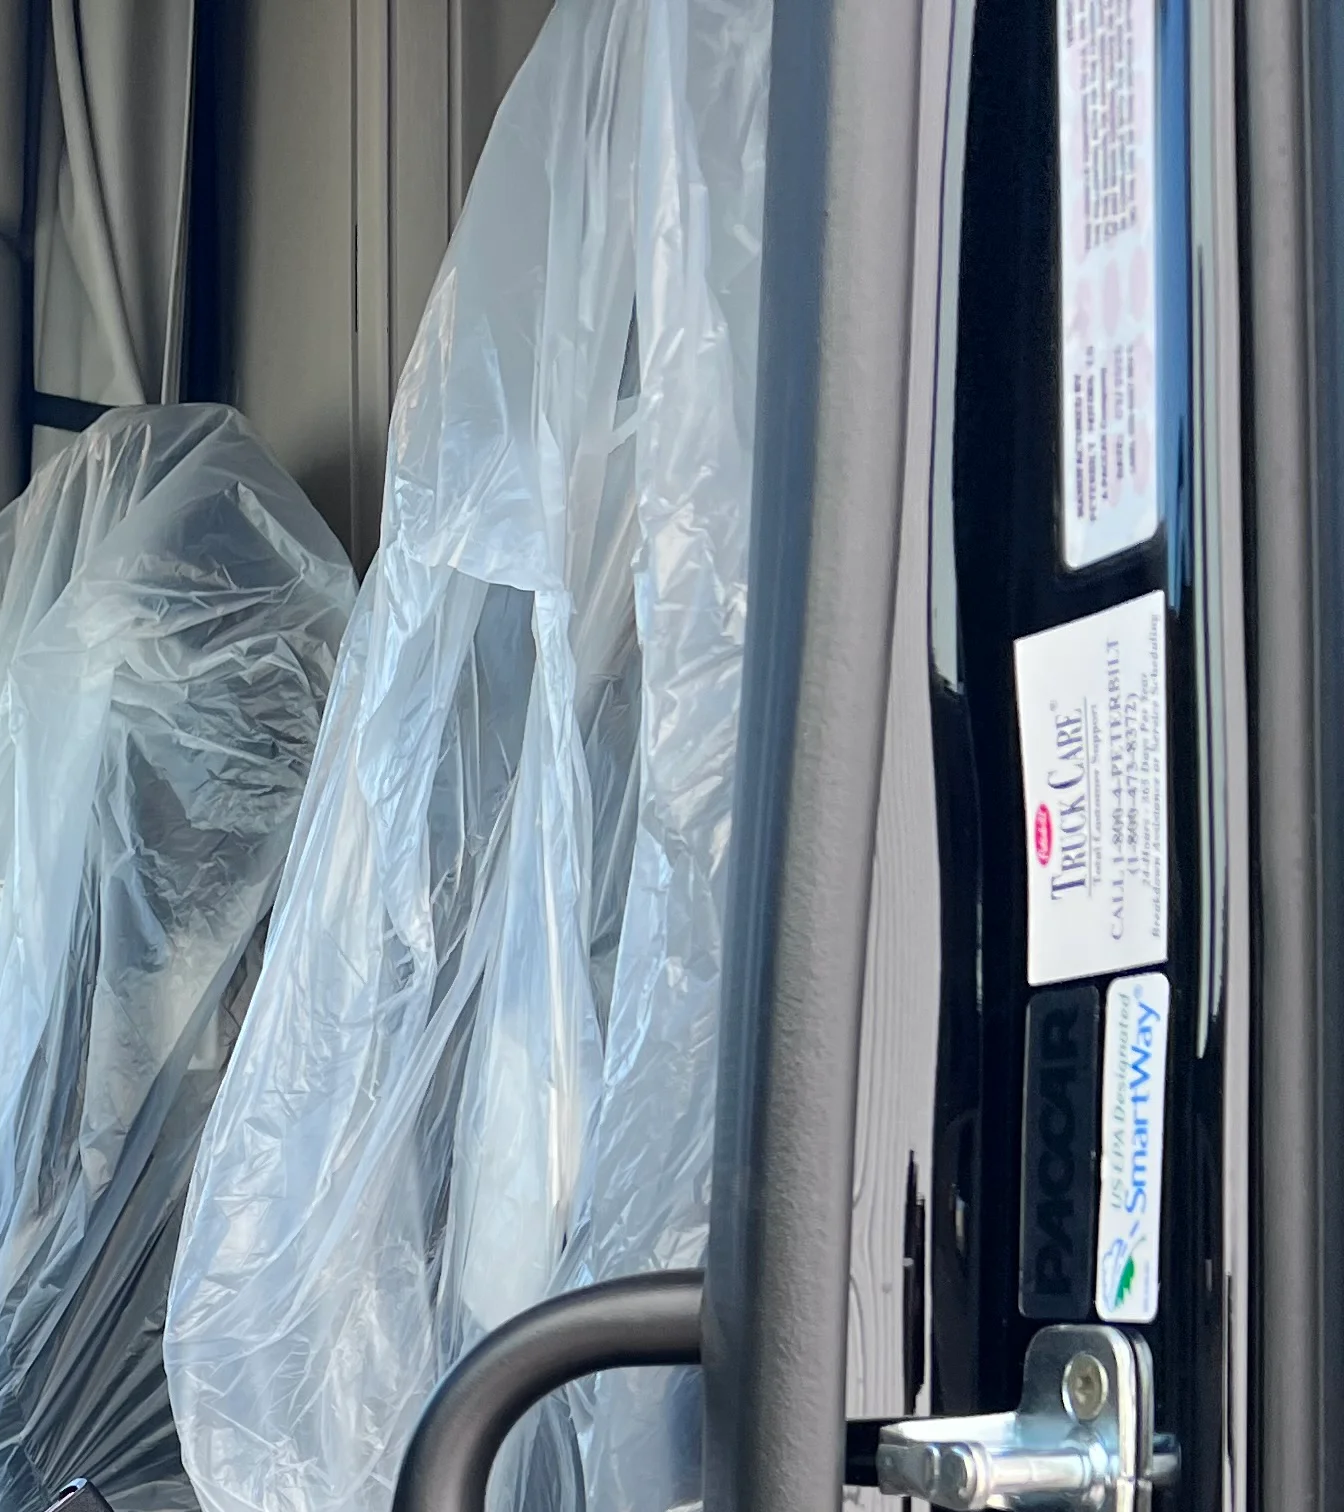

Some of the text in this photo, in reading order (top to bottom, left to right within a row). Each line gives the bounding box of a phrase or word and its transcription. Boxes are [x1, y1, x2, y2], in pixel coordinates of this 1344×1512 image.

[1112, 870, 1124, 940] CALL
[1035, 1008, 1079, 1295] PACCAR
[1125, 1002, 1160, 1213] SmartWay
